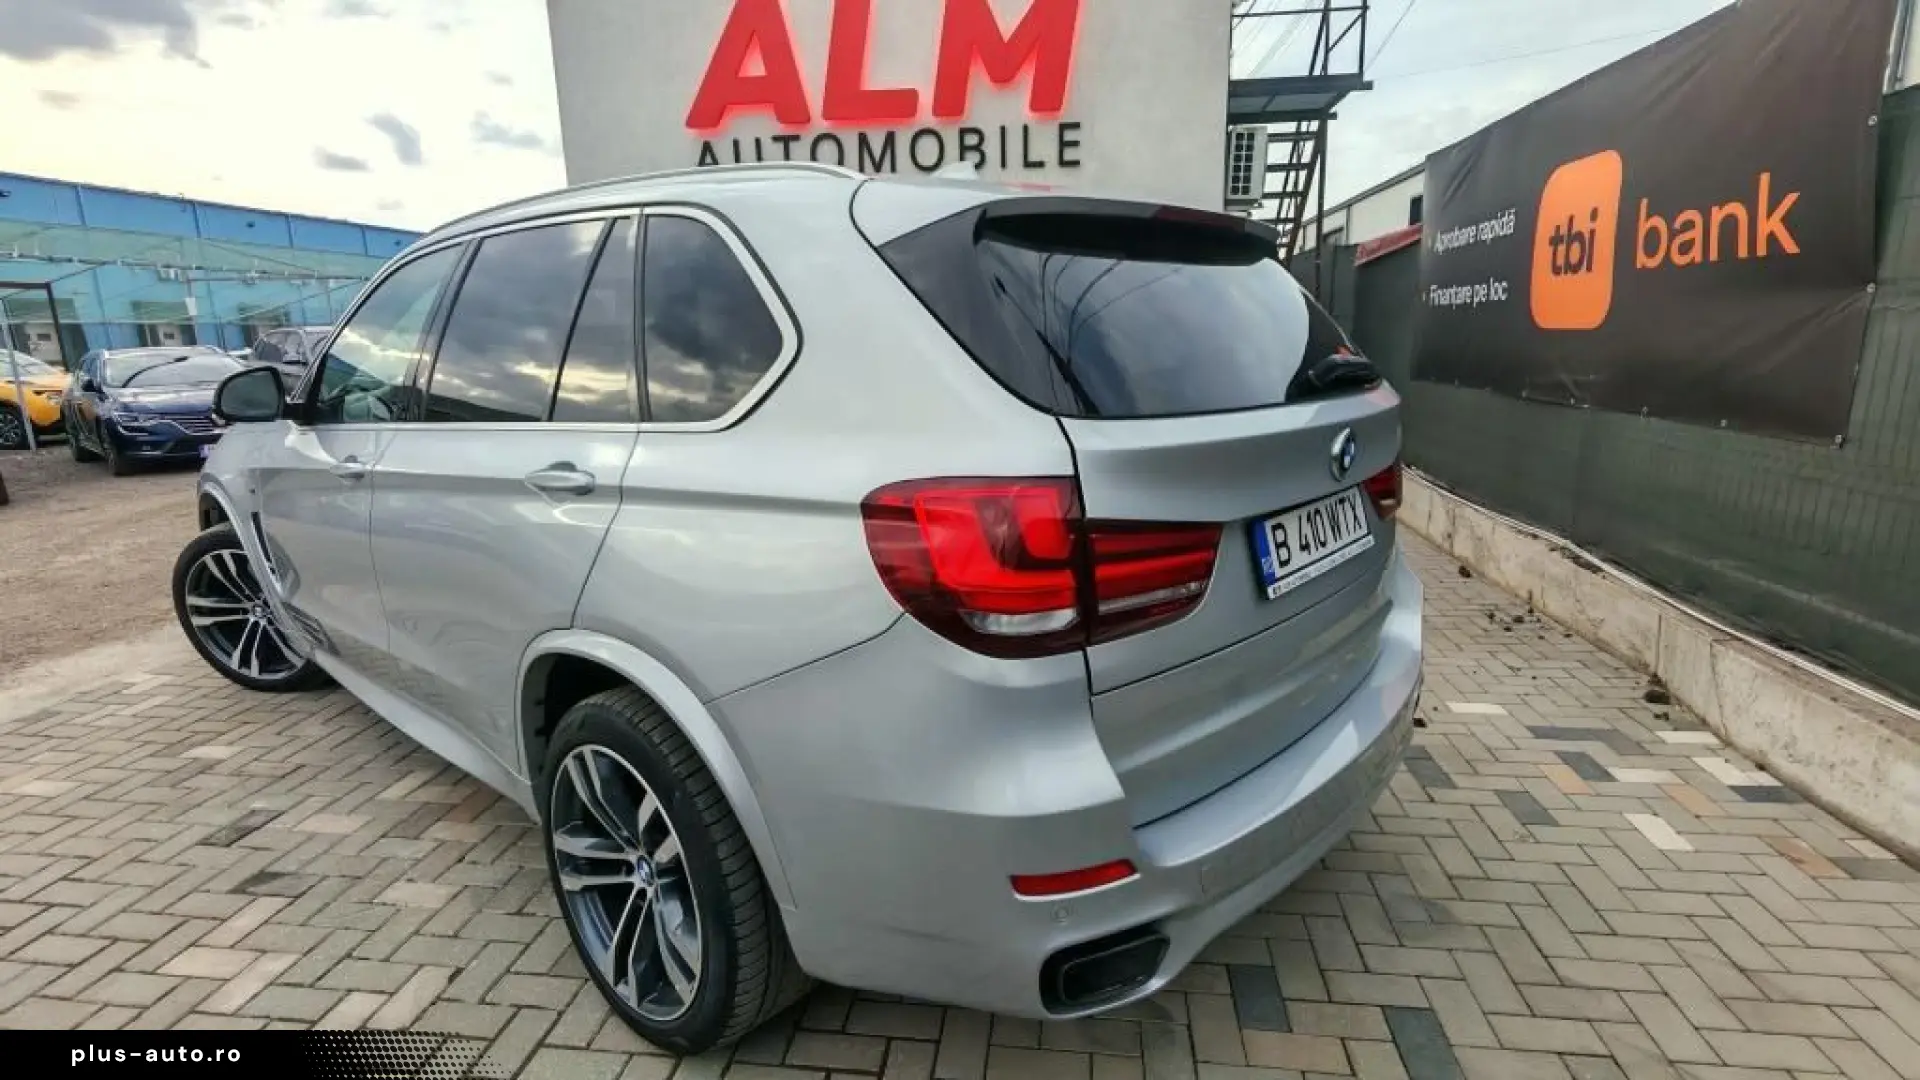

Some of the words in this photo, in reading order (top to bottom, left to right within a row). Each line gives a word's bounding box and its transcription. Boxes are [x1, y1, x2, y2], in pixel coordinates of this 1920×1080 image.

[685, 0, 1079, 128] ALM
[1548, 206, 1598, 276] tbi
[1636, 172, 1801, 269] bank
[1473, 284, 1488, 308] pe
[1489, 276, 1508, 301] loc
[1270, 522, 1291, 568] B
[1298, 507, 1327, 556] 410
[1325, 493, 1363, 543] WTX
